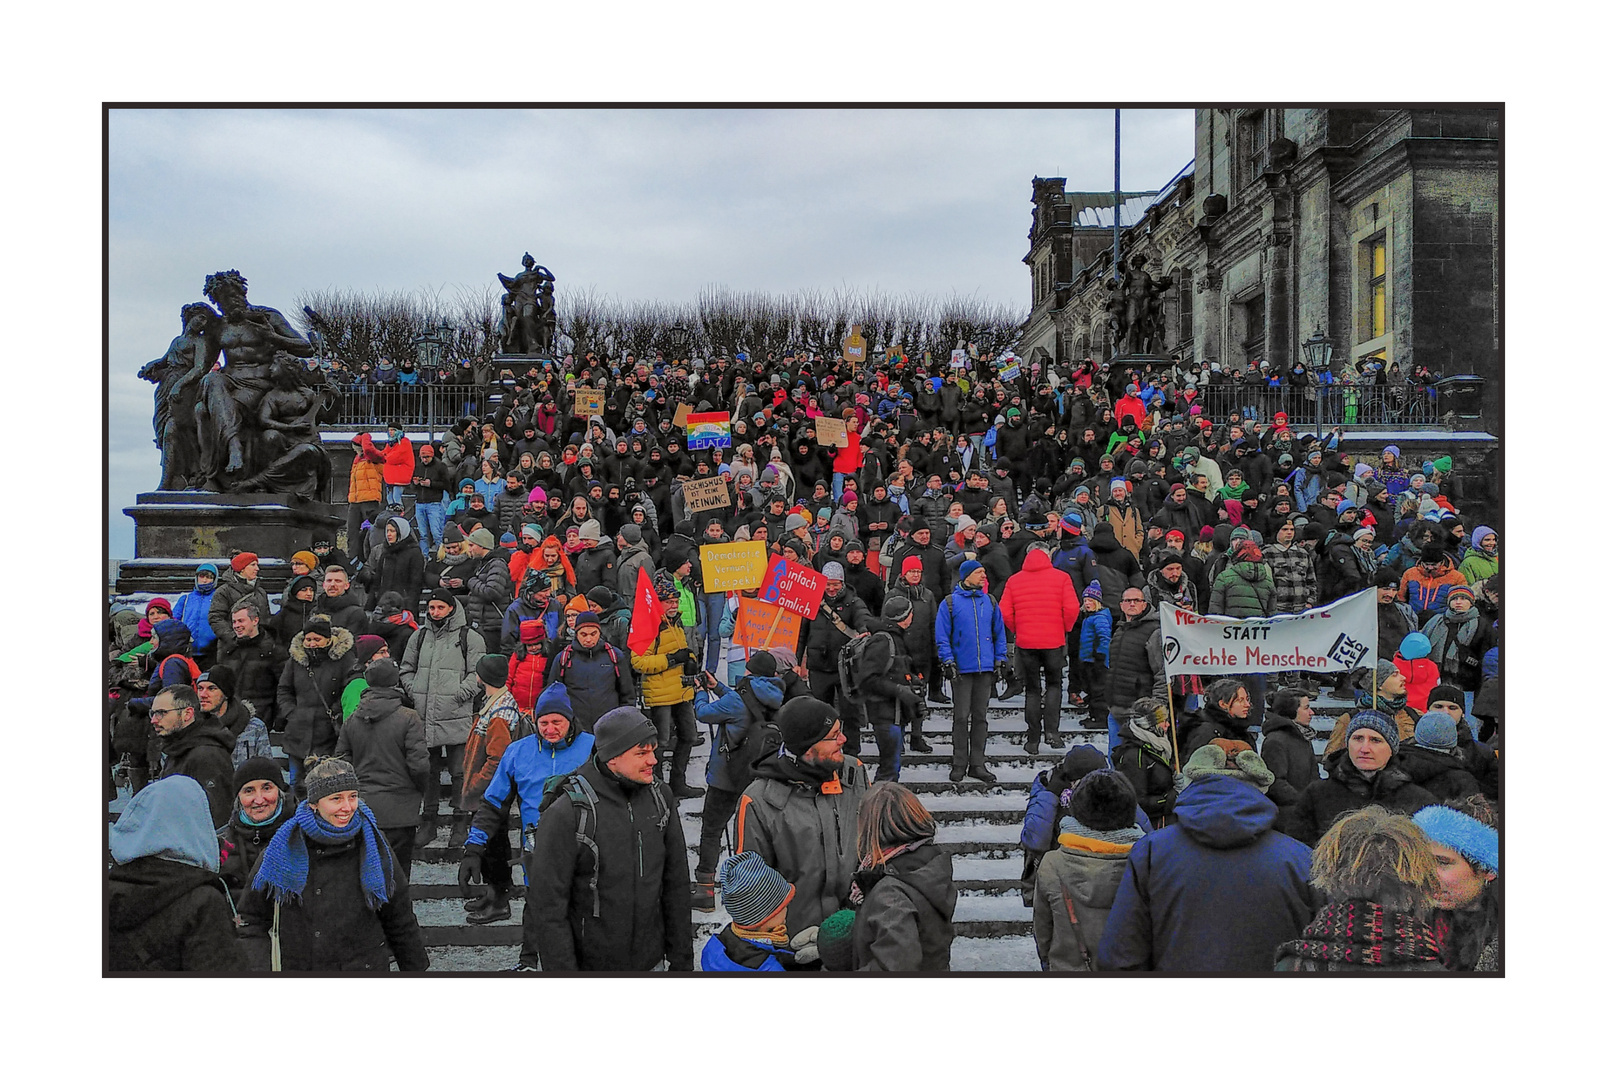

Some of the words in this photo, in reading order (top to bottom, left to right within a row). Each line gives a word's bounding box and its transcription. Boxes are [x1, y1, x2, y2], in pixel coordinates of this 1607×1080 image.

[695, 437, 729, 449] PLATZ
[683, 477, 724, 492] FASCHISMUS
[690, 493, 728, 509] MEINUNG
[764, 584, 811, 616] Dämlich
[780, 614, 793, 625] nd
[745, 619, 794, 638] Angstache
[1223, 625, 1271, 640] STATT
[1182, 647, 1238, 666] rechte
[1245, 645, 1328, 668] Menschen
[1332, 635, 1358, 664] FCK
[1344, 642, 1363, 669] AFD
